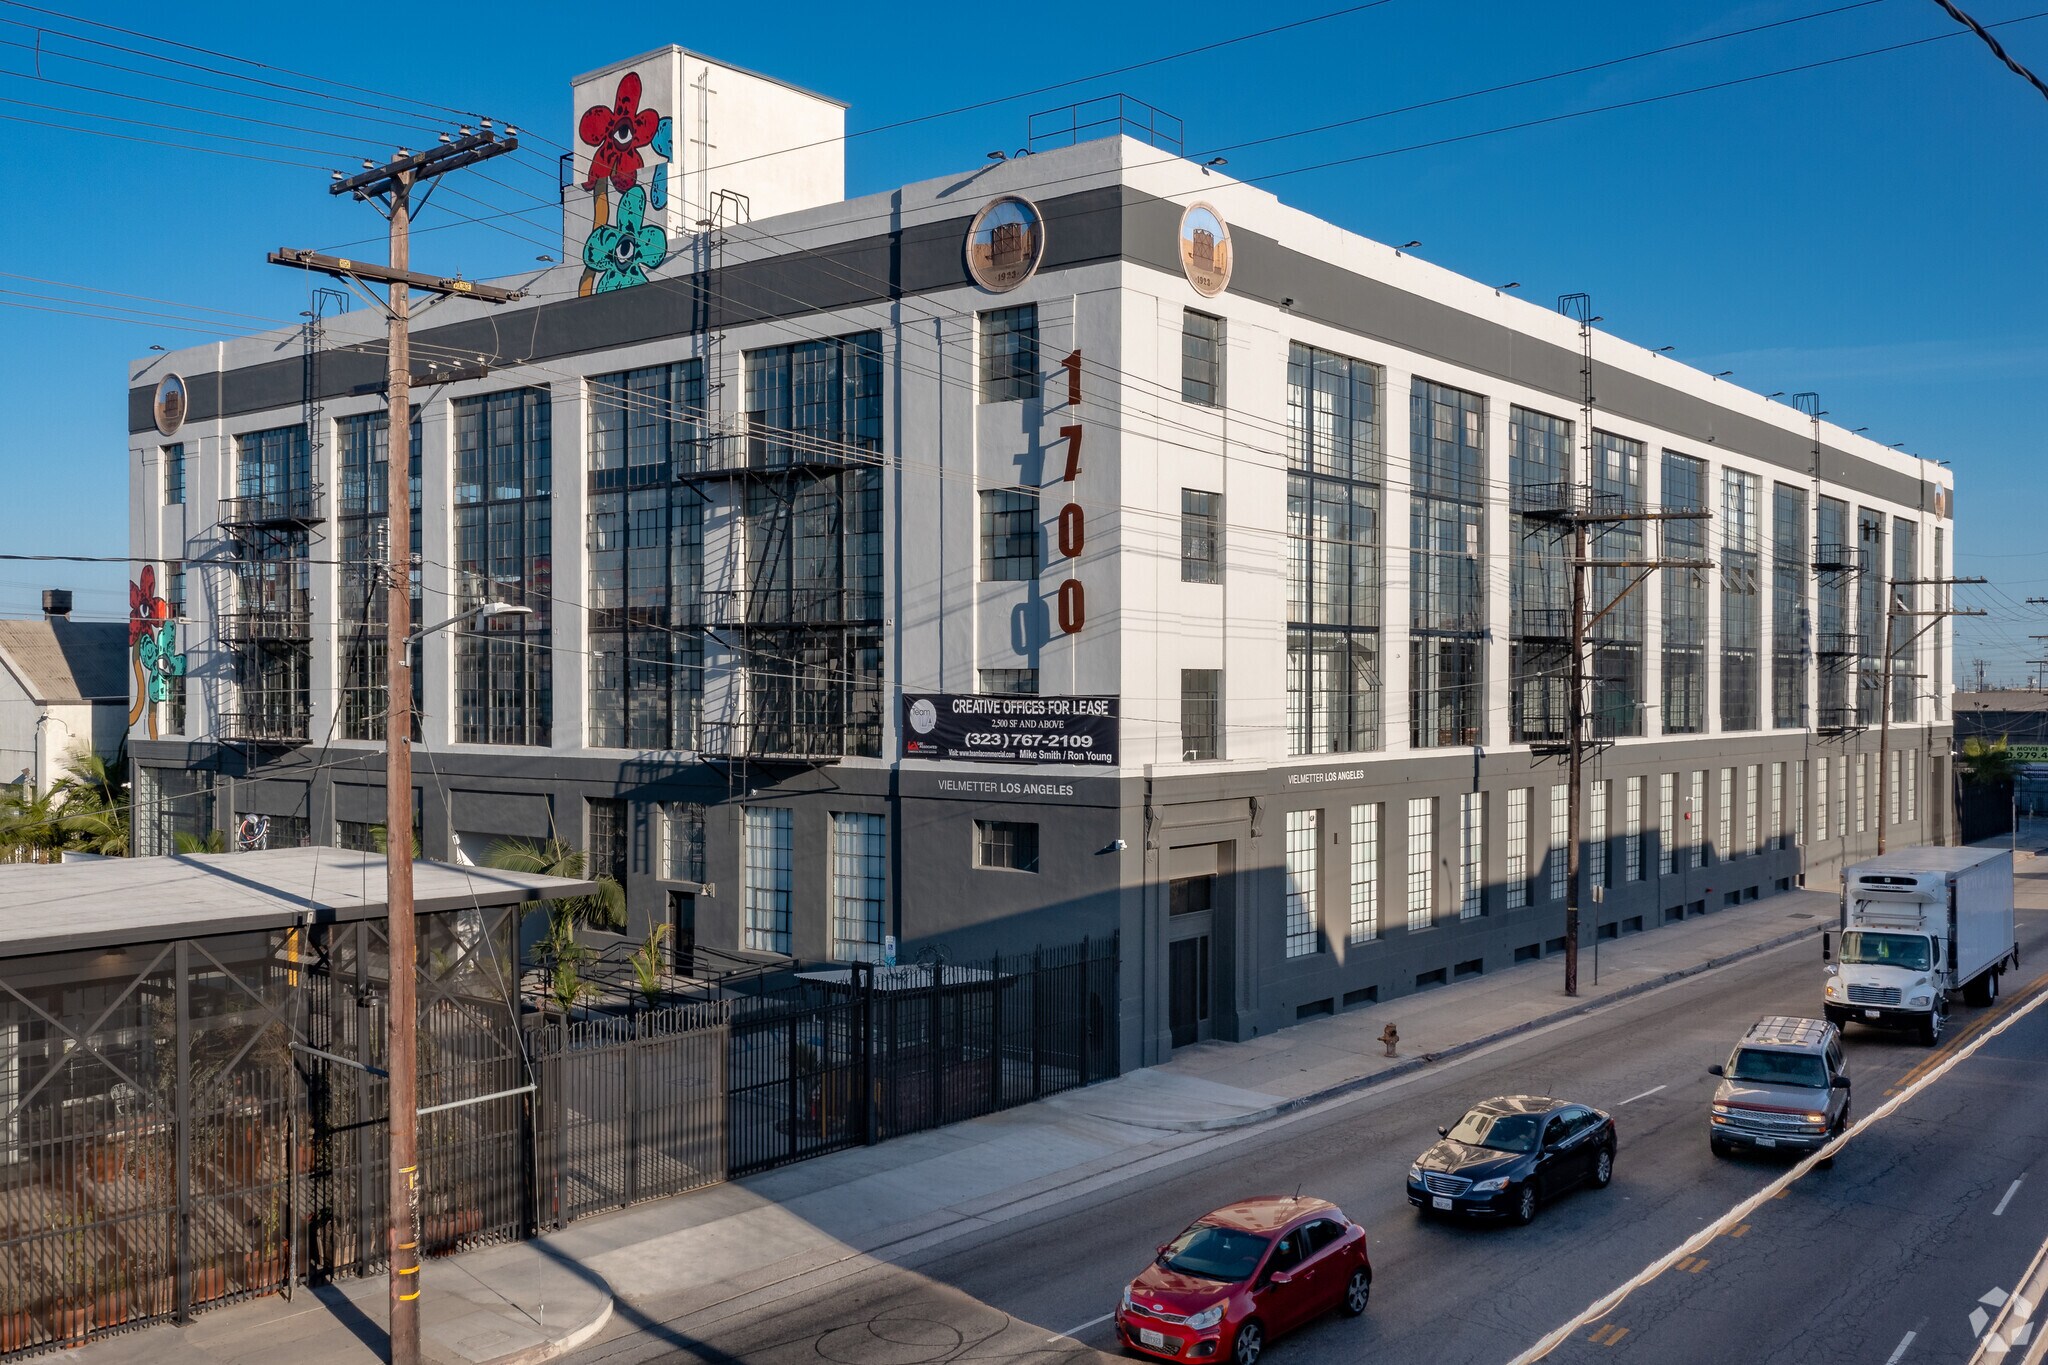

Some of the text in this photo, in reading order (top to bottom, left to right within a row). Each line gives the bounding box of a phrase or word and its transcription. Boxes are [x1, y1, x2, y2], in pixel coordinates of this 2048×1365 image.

[1058, 349, 1084, 634] 1700
[912, 707, 931, 717] Team
[953, 699, 1109, 716] CREATIVE OFFICES FOR LEASE
[1009, 719, 1019, 729] SF
[1019, 720, 1037, 729] AND
[1037, 720, 1064, 729] ABOVE
[1011, 734, 1093, 748] 767-2109
[1019, 750, 1038, 760] Mike
[1038, 750, 1061, 760] Smith
[1062, 751, 1066, 760] /
[1067, 751, 1085, 761] Ron
[1085, 751, 1112, 763] Young
[1288, 770, 1364, 784] VIELMETTER LOS ANGELES
[938, 779, 1073, 796] VIELMETTER LOS ANGELES
